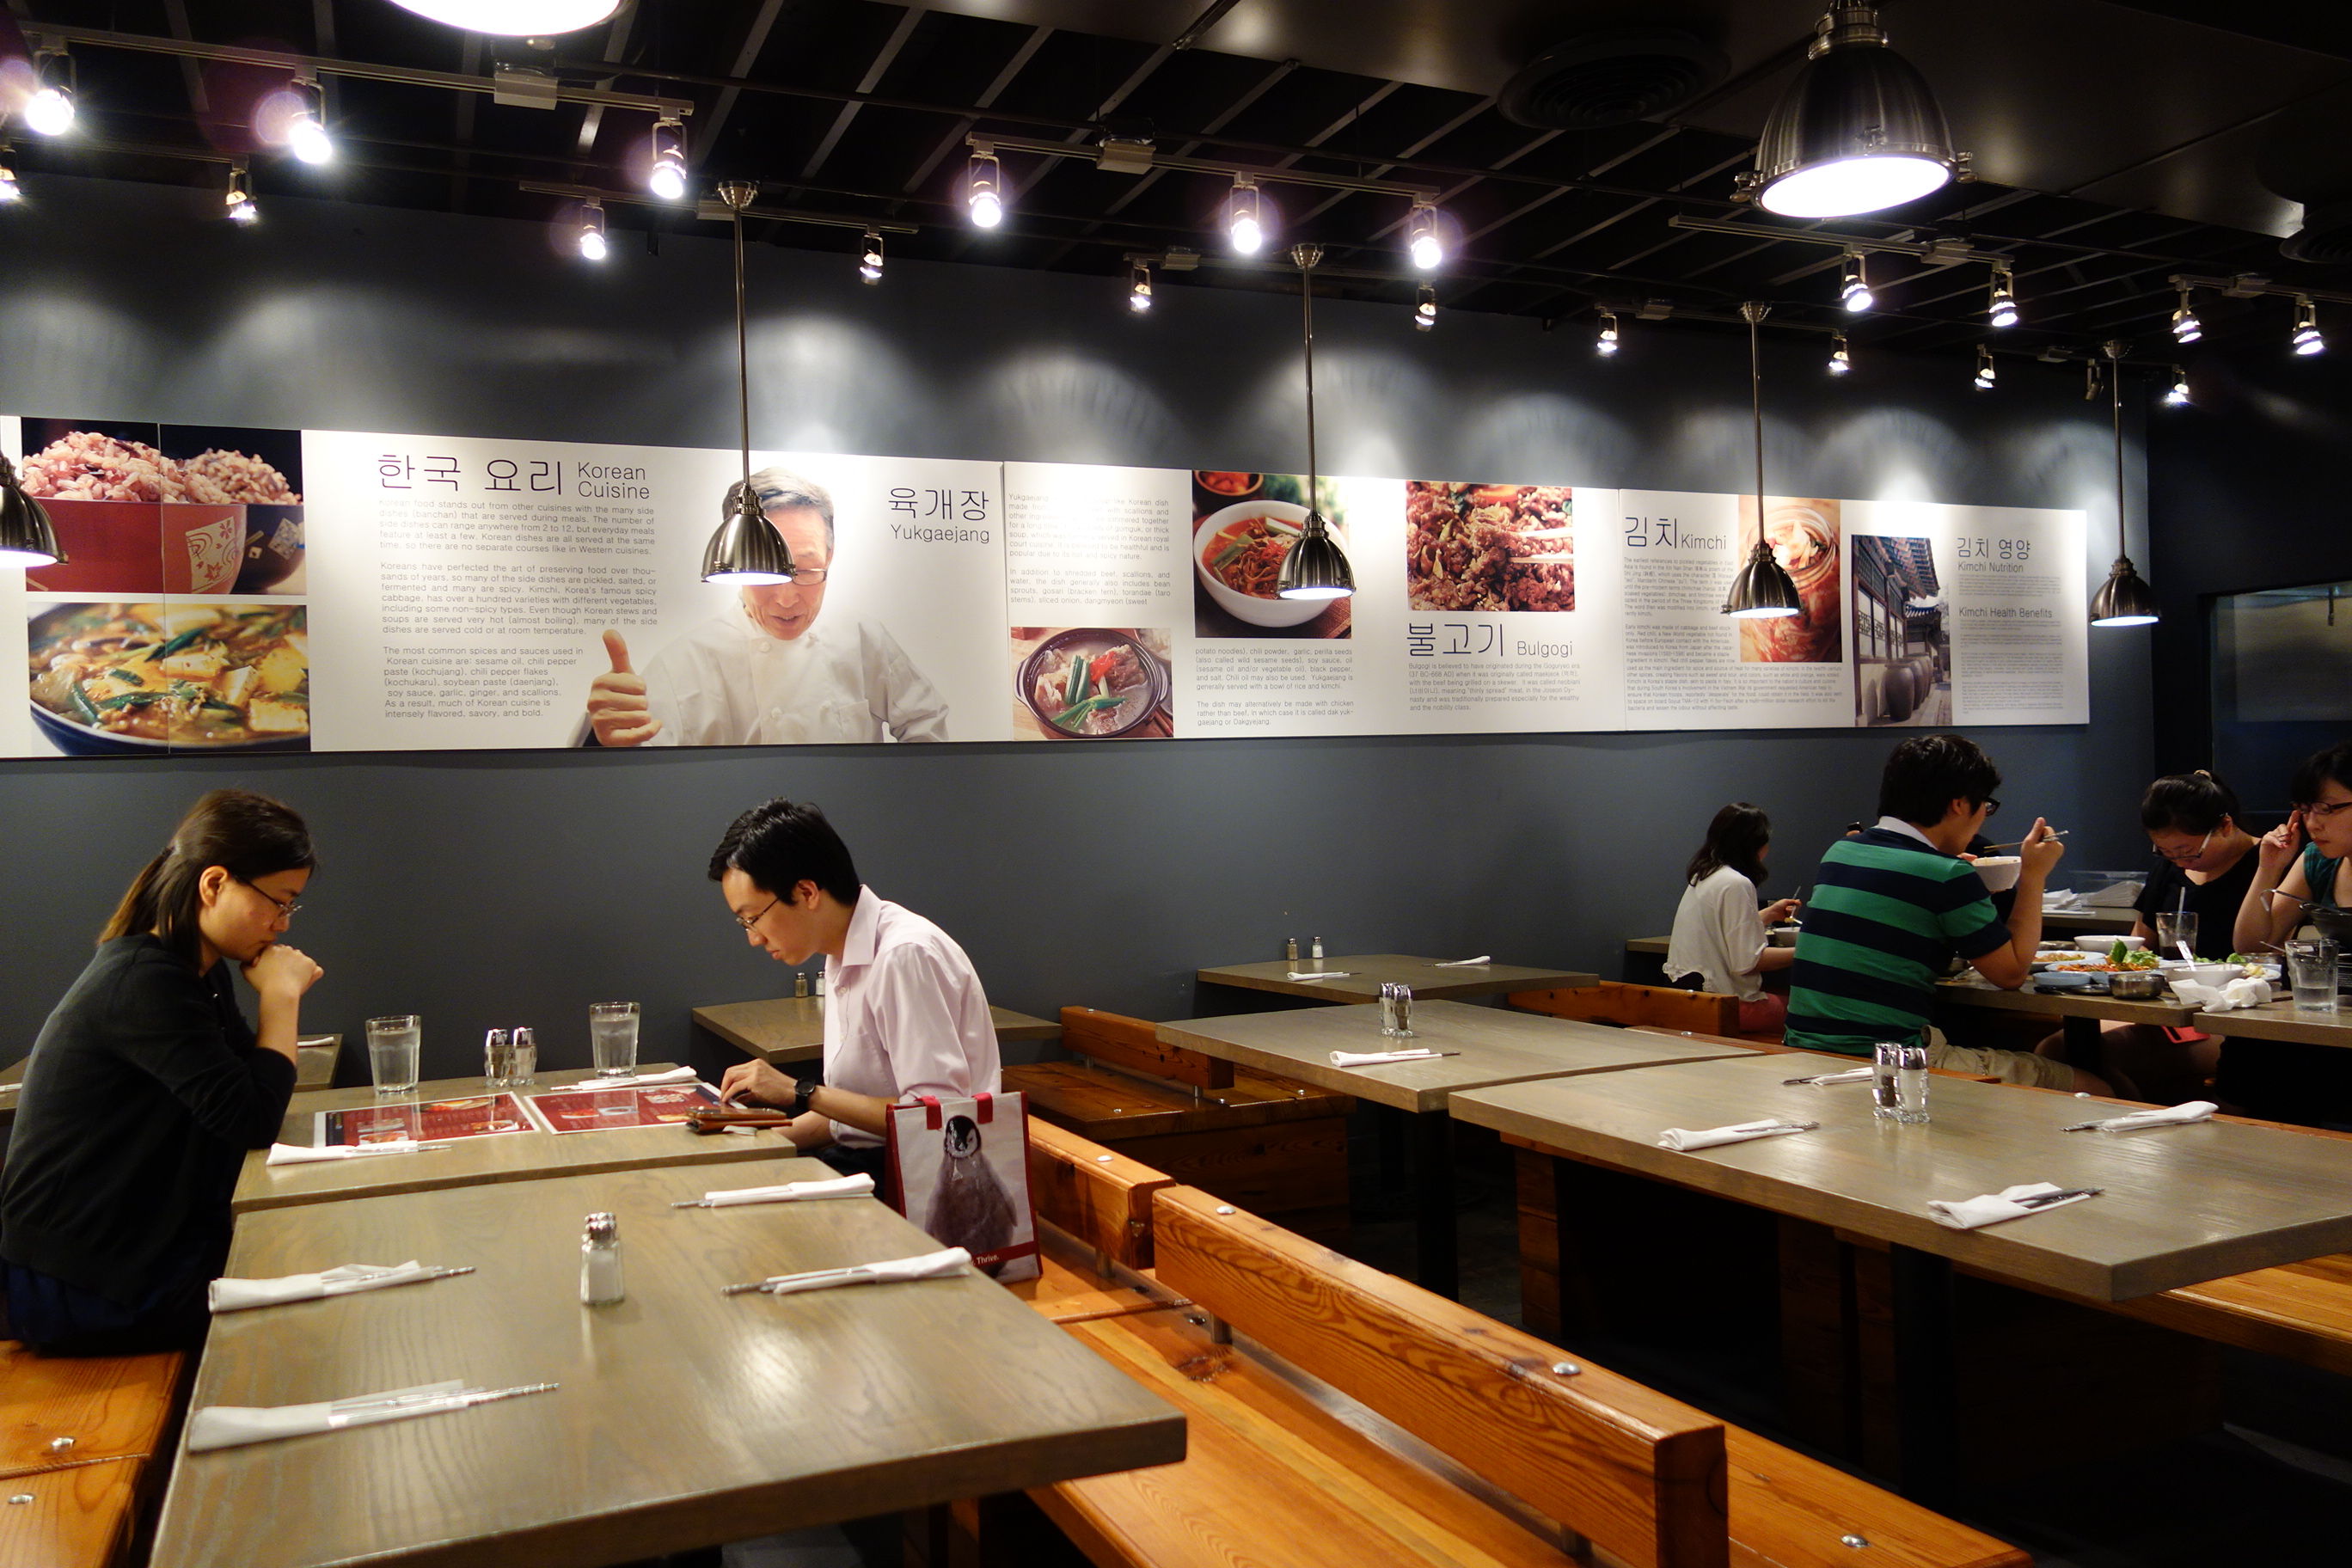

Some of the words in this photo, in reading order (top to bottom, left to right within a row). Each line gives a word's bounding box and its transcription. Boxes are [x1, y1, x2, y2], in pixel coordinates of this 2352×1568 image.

[378, 455, 461, 491] 한국
[485, 460, 560, 495] 요리
[579, 462, 645, 482] Korean
[579, 481, 649, 499] Cuisine
[889, 488, 989, 521] 육개장
[891, 524, 989, 544] Yukgaejang
[1625, 517, 1676, 548] 김치
[1681, 534, 1725, 549] Kimchi
[420, 542, 442, 550] there
[475, 542, 512, 554] separate
[579, 544, 613, 553] Western
[1957, 538, 1988, 559] 김치
[1999, 539, 2030, 560] 영양
[381, 562, 417, 571] Koreans
[447, 563, 489, 573] perfected
[526, 564, 536, 573] of
[540, 564, 584, 575] preserving
[588, 565, 607, 573] food
[1958, 561, 1987, 573] Kimchi
[1989, 562, 2023, 573] Nutrition
[1069, 579, 1099, 588] generally
[382, 583, 426, 591] fermented
[601, 585, 631, 594] famous
[635, 586, 657, 597] spicy
[382, 604, 423, 614] including
[452, 604, 497, 615] non-spicy
[529, 605, 550, 614] Even
[552, 606, 581, 616] though
[616, 606, 640, 615] stews
[1959, 607, 1988, 617] Kimchi
[1990, 608, 2016, 617] Health
[2018, 608, 2052, 619] Benefits
[432, 625, 461, 634] served
[1407, 623, 1503, 657] 불고기
[469, 646, 498, 657] spices
[1517, 641, 1572, 658] Bulgogi
[383, 667, 408, 677] paste
[524, 667, 548, 676] flakes
[444, 677, 480, 688] soybean
[483, 677, 506, 688] paste
[1197, 683, 1225, 691] generally
[503, 688, 519, 696] and
[477, 698, 507, 707] Korean
[511, 698, 541, 707] cuisine
[543, 698, 550, 707] is
[1245, 700, 1282, 708] alternatively
[385, 709, 425, 719] intensely
[1197, 718, 1223, 727] gaejang
[977, 1254, 999, 1265] Thrive.
